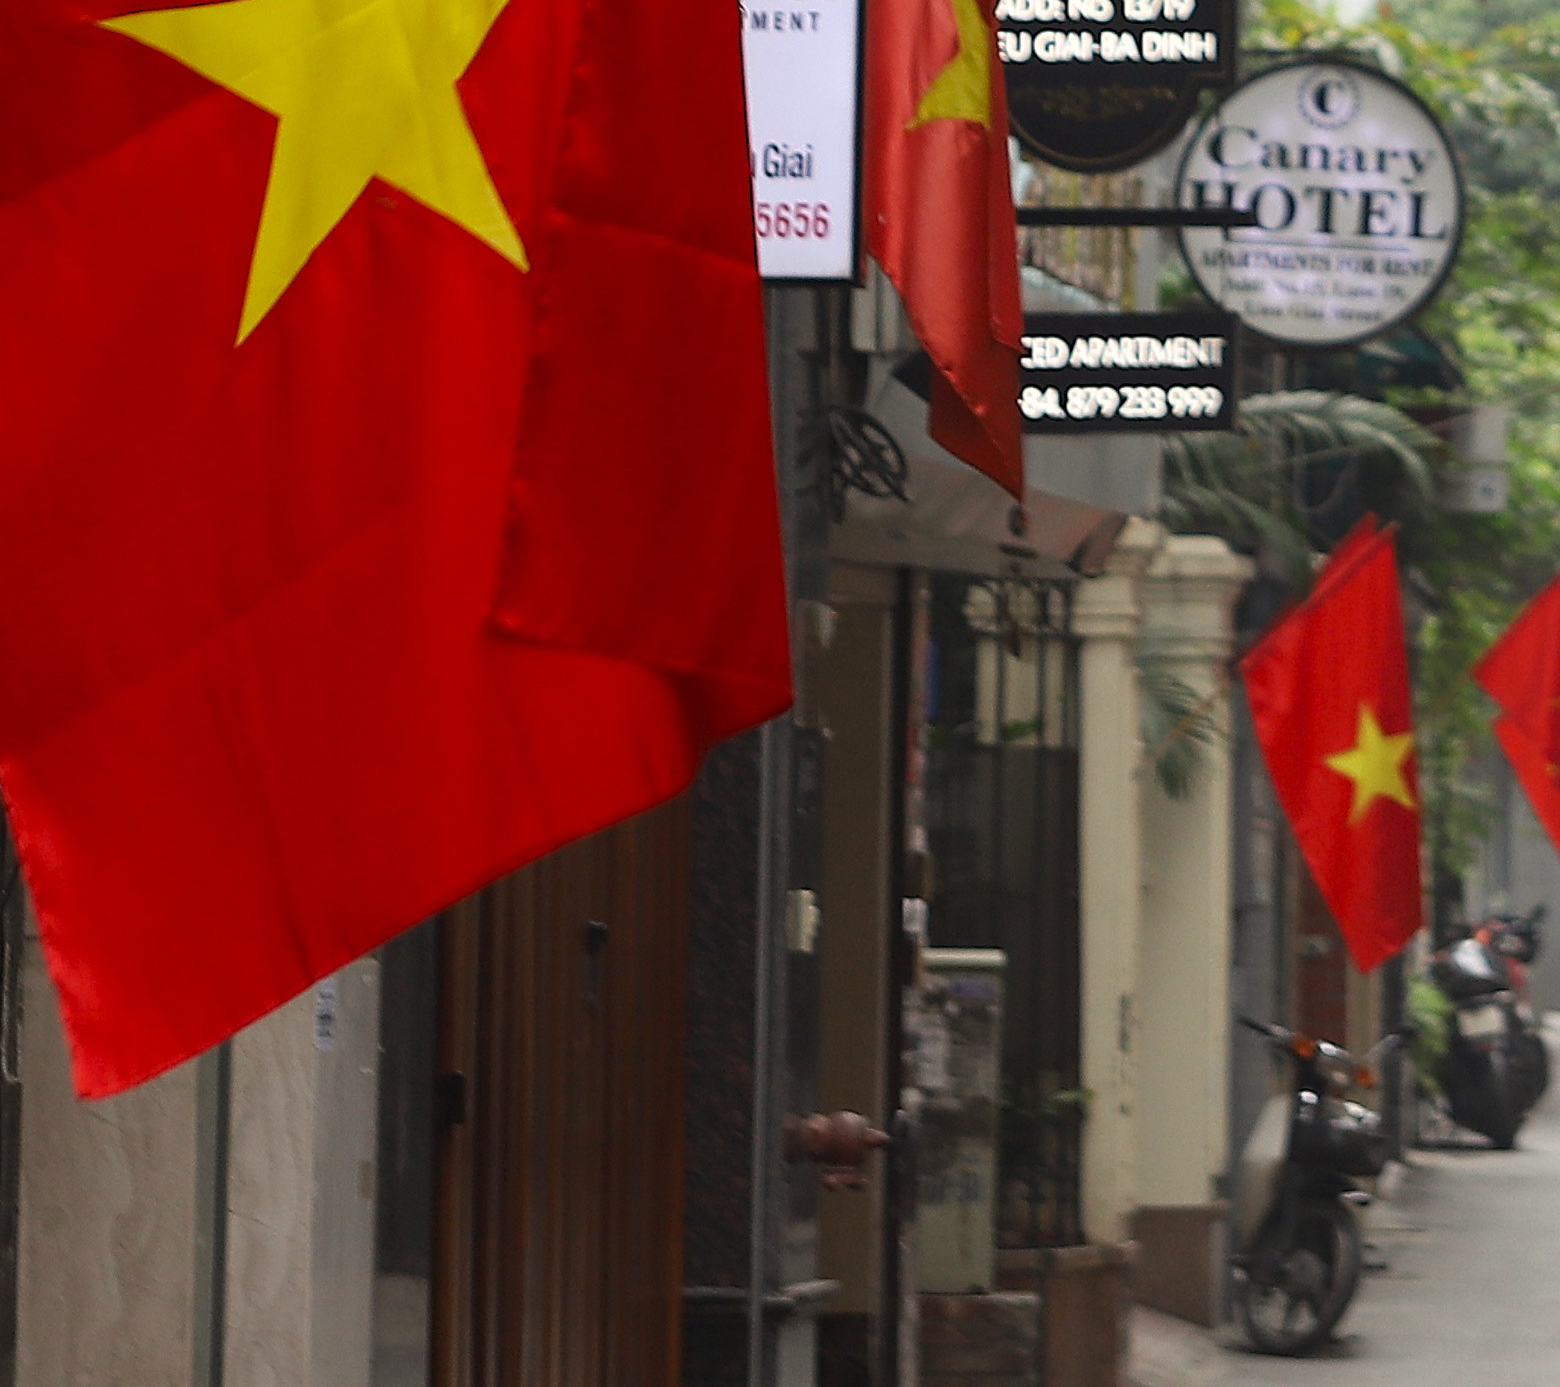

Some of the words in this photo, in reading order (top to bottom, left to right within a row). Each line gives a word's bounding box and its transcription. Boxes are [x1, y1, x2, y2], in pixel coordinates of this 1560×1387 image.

[743, 11, 822, 32] MENT
[1141, 30, 1218, 63] DINH
[762, 143, 814, 179] Giai
[1208, 126, 1434, 185] Canary
[1190, 180, 1449, 240] HOTEL
[1069, 336, 1228, 369] APARTMENT
[1016, 386, 1067, 419] 84.
[1066, 386, 1121, 419] 879
[1167, 386, 1224, 419] 999
